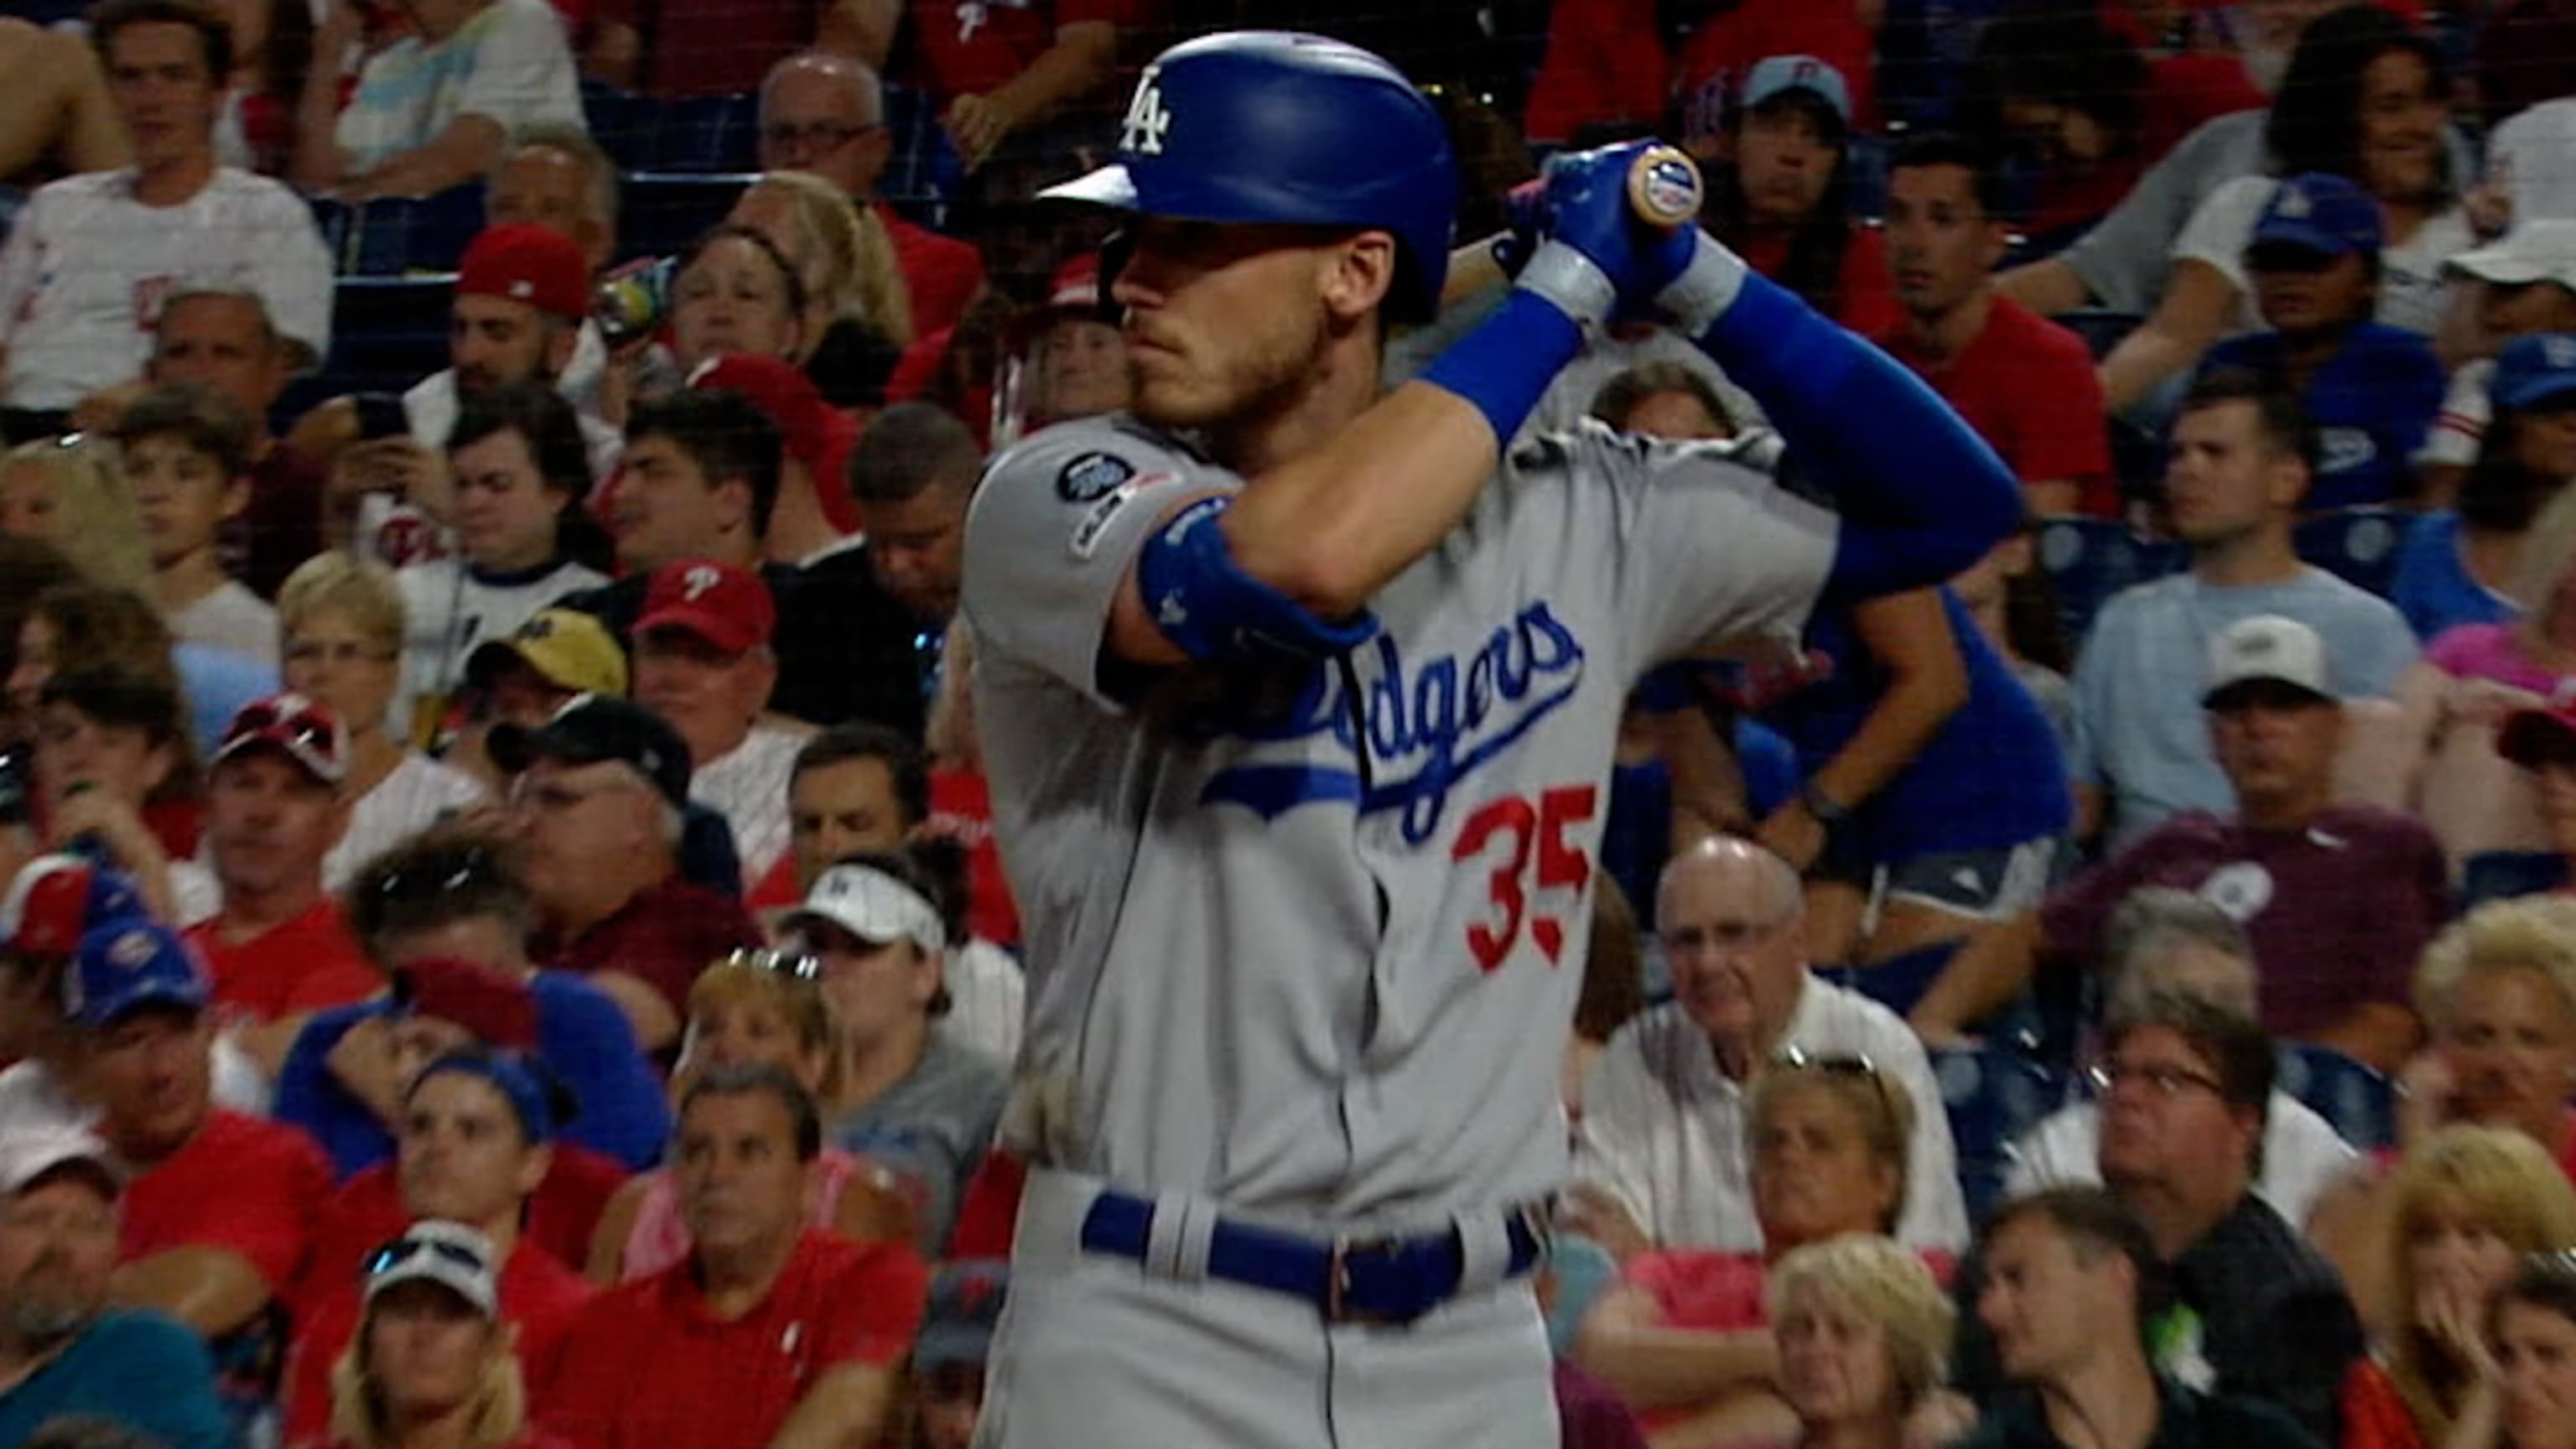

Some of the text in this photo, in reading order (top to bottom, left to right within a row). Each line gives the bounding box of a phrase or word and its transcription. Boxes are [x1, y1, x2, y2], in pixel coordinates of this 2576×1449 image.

[1119, 66, 1171, 154] LA
[684, 567, 719, 602] P
[1452, 786, 1597, 974] 35
